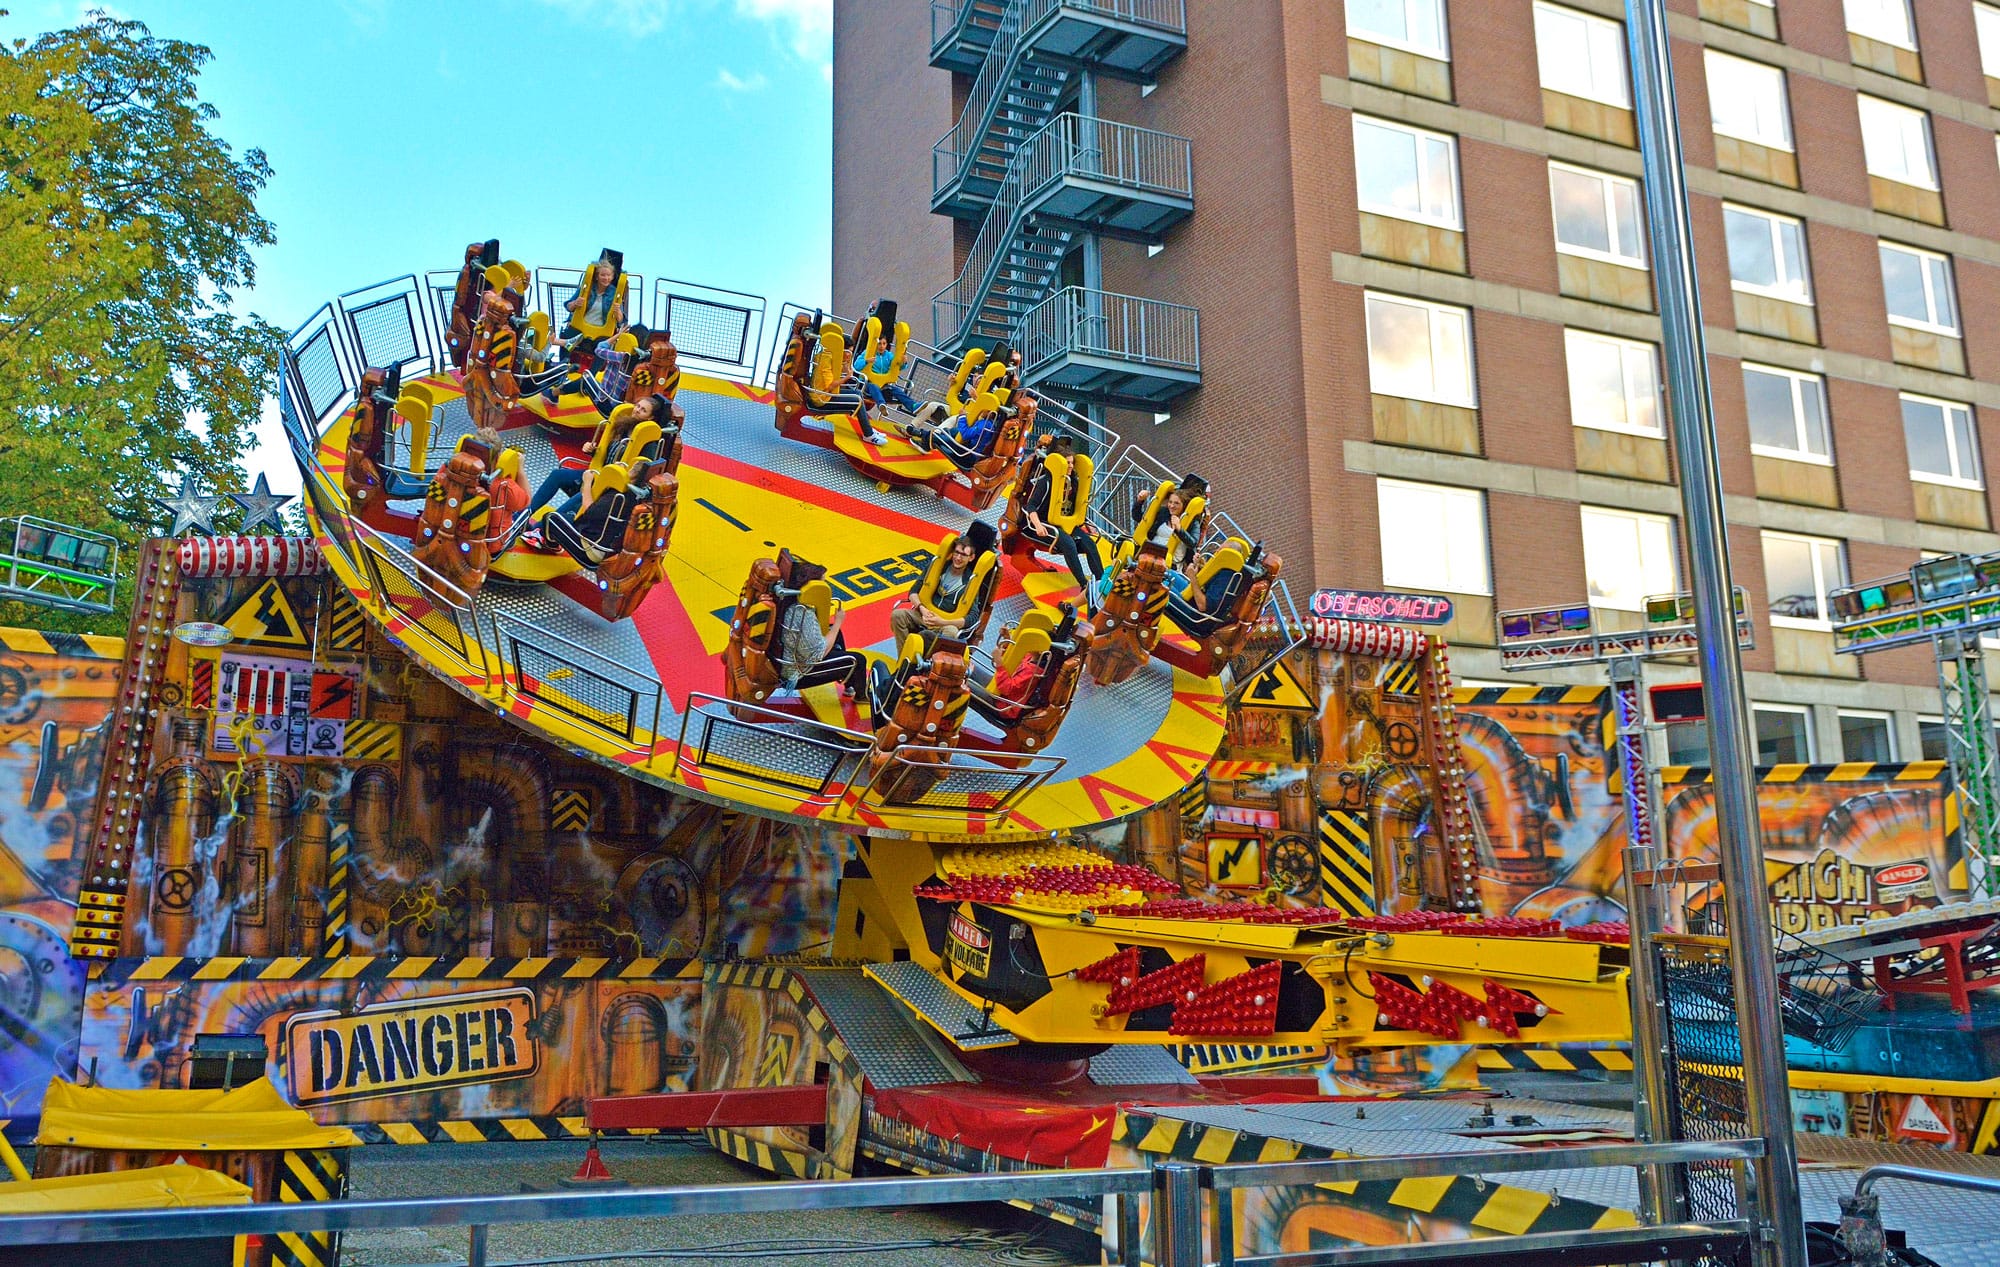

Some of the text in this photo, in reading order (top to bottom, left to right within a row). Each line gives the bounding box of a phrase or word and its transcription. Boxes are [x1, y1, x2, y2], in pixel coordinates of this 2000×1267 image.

[1314, 593, 1449, 618] OBERSCHELP
[1775, 848, 1867, 901] HIGH
[1881, 867, 1923, 882] DANGER
[309, 1007, 517, 1092] DANGER
[1908, 1118, 1940, 1131] DANGER
